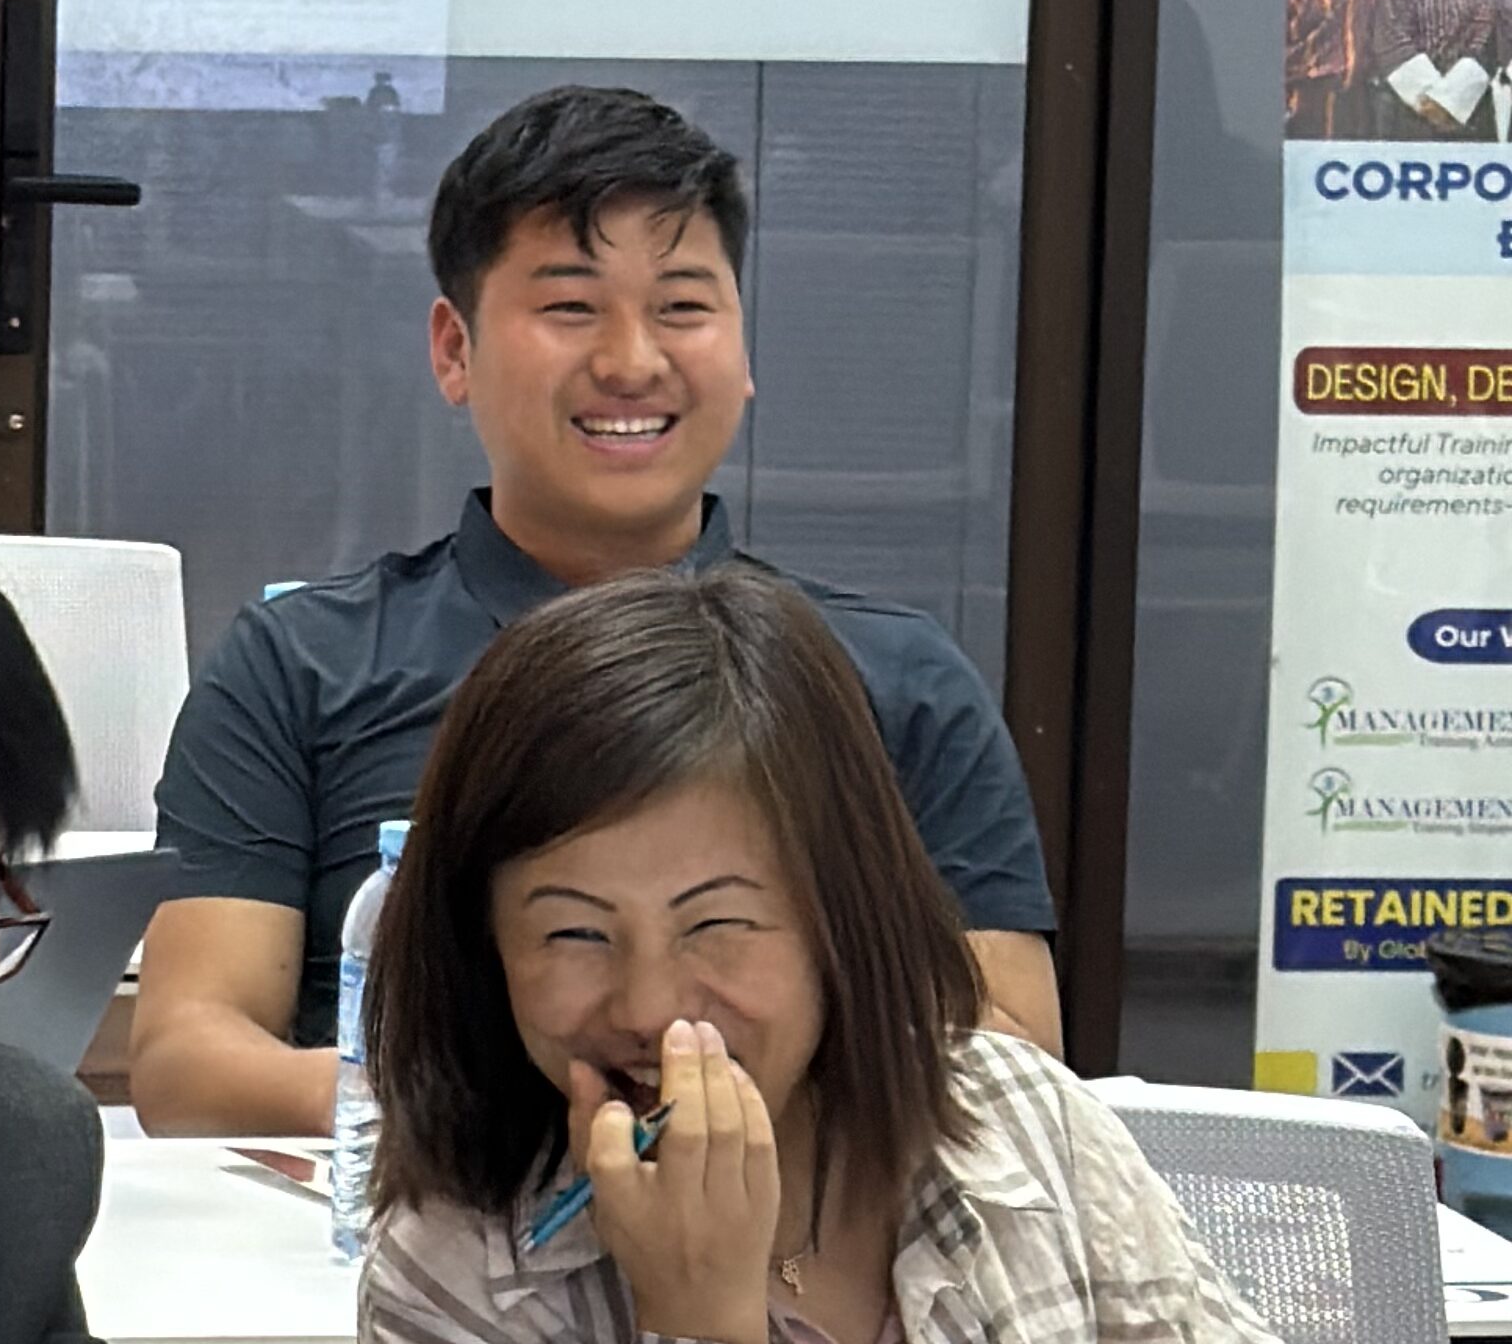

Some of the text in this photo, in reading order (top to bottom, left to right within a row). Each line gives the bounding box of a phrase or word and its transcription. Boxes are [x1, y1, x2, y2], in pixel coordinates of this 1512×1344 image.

[1307, 364, 1458, 408] DESIGN,
[1312, 432, 1432, 457] Impactful
[1435, 624, 1491, 648] Our
[1291, 889, 1512, 926] RETAINED
